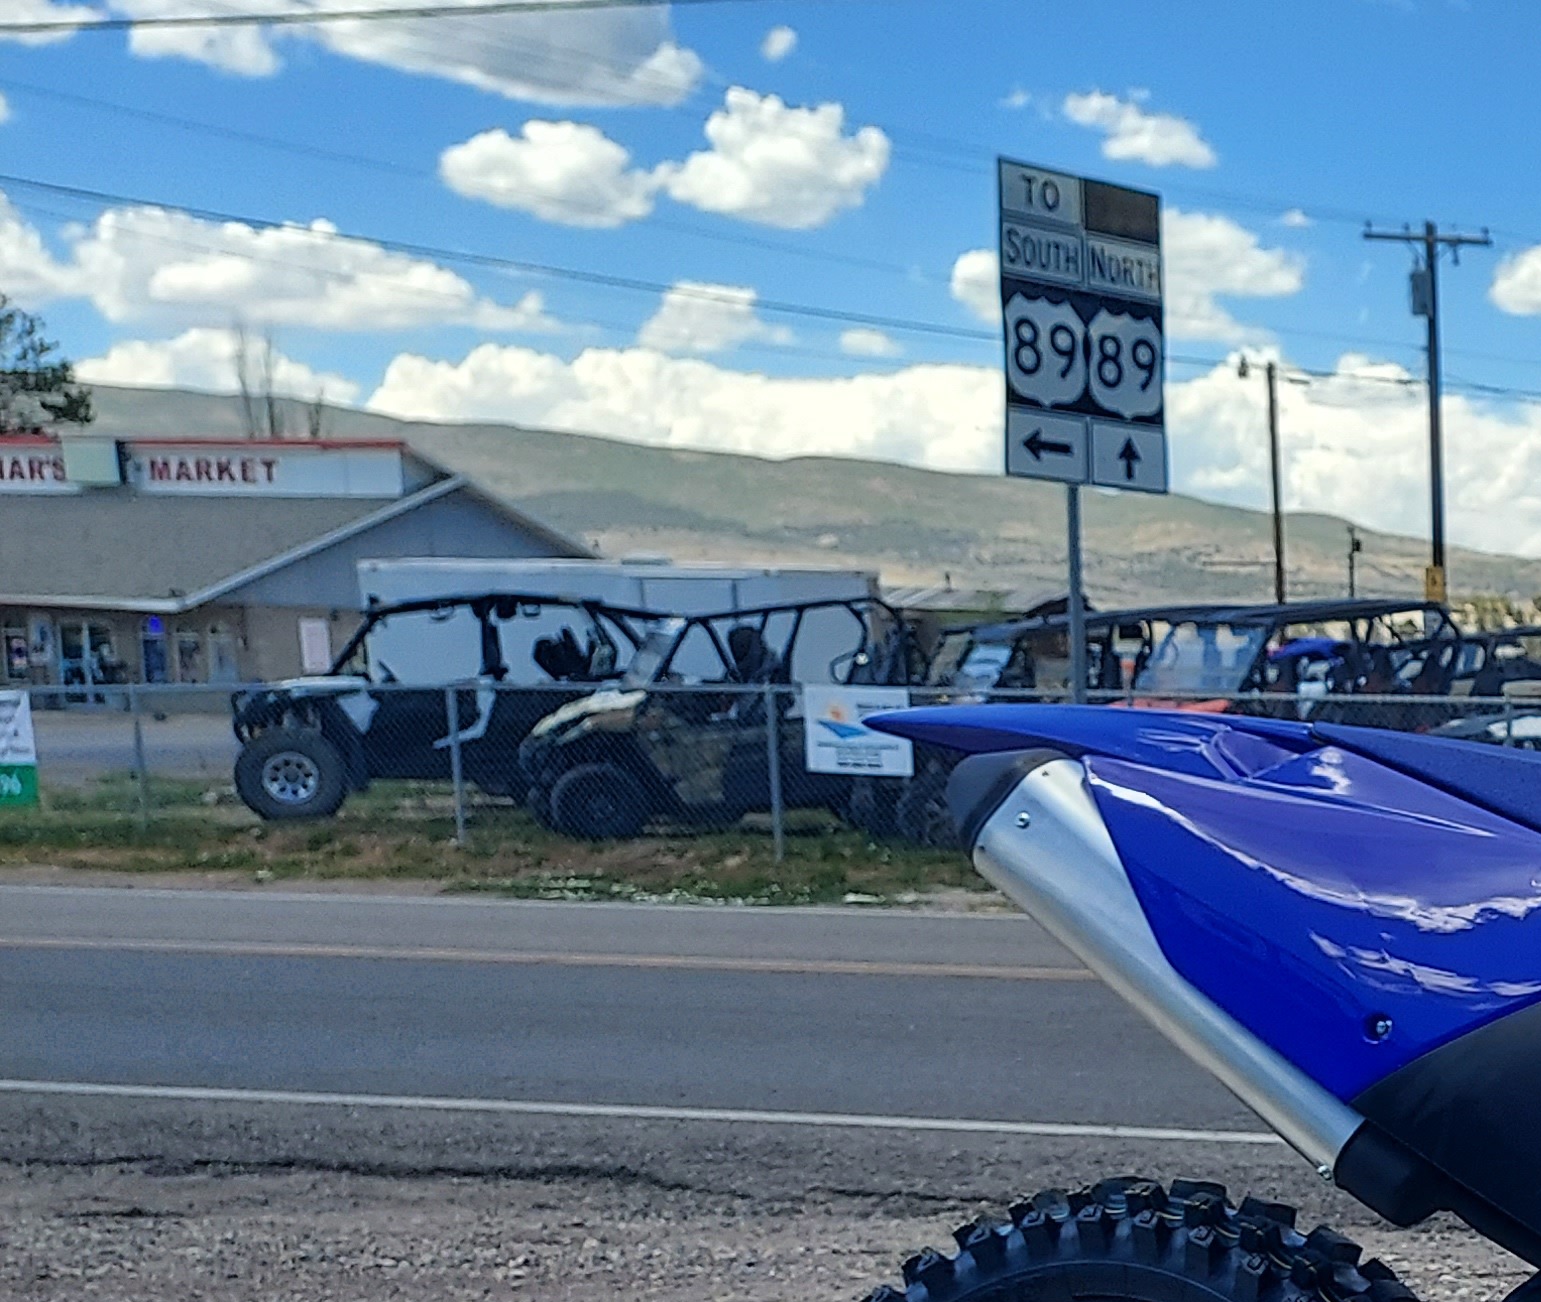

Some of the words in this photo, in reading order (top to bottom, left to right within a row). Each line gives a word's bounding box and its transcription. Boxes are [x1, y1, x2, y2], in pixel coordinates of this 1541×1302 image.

[1021, 173, 1061, 211] TO
[1006, 226, 1080, 275] SOUTH
[1091, 245, 1160, 289] NORTH
[1014, 317, 1076, 379] 89
[1097, 334, 1156, 392] 89
[149, 457, 278, 483] MARKET
